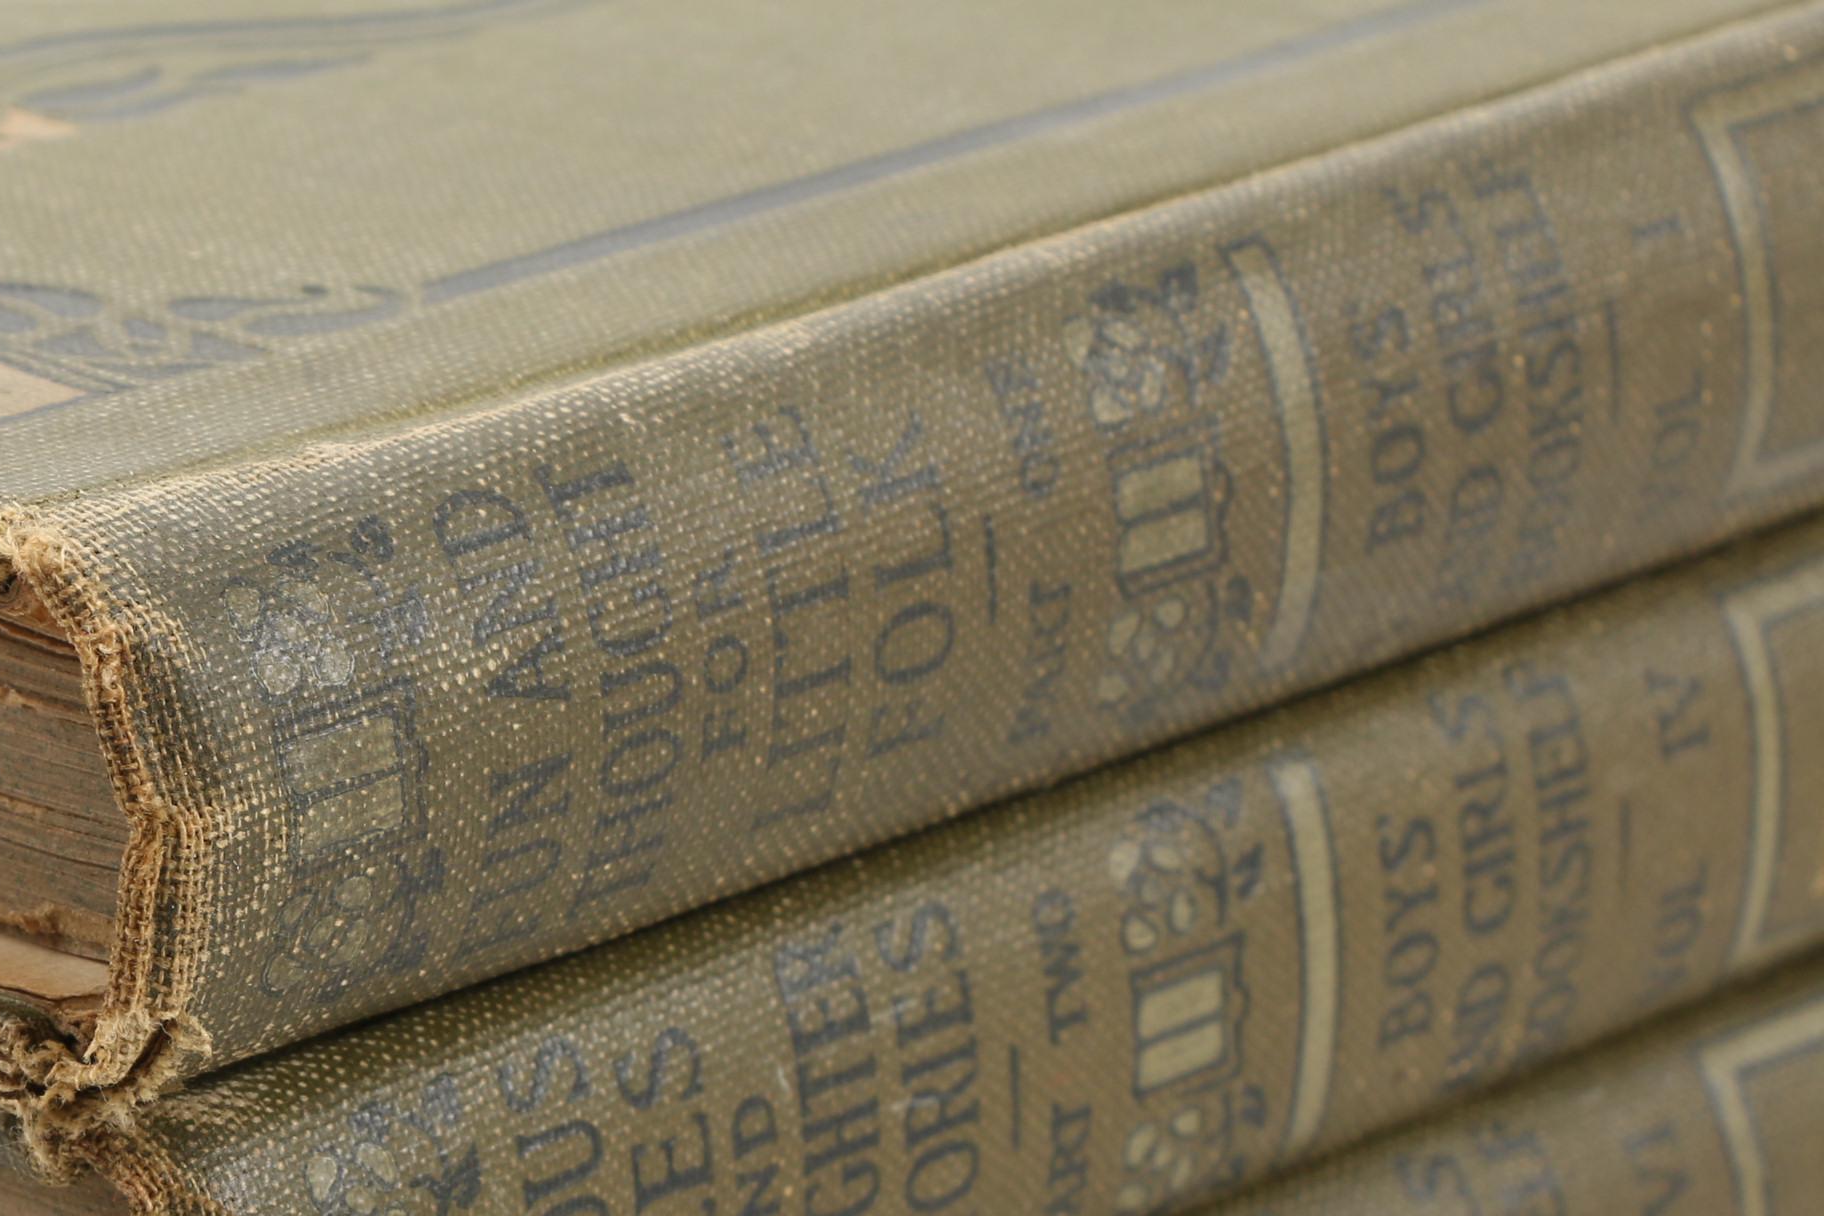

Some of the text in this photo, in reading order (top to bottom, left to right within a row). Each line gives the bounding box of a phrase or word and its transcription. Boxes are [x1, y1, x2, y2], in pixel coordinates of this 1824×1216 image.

[432, 487, 571, 703] AND
[533, 459, 682, 921] THOUGHT
[693, 551, 748, 761] FOR
[721, 406, 853, 835] LITTLE
[848, 413, 954, 759] FOLK
[1643, 670, 1711, 764] IV
[1032, 888, 1088, 1045] TWO
